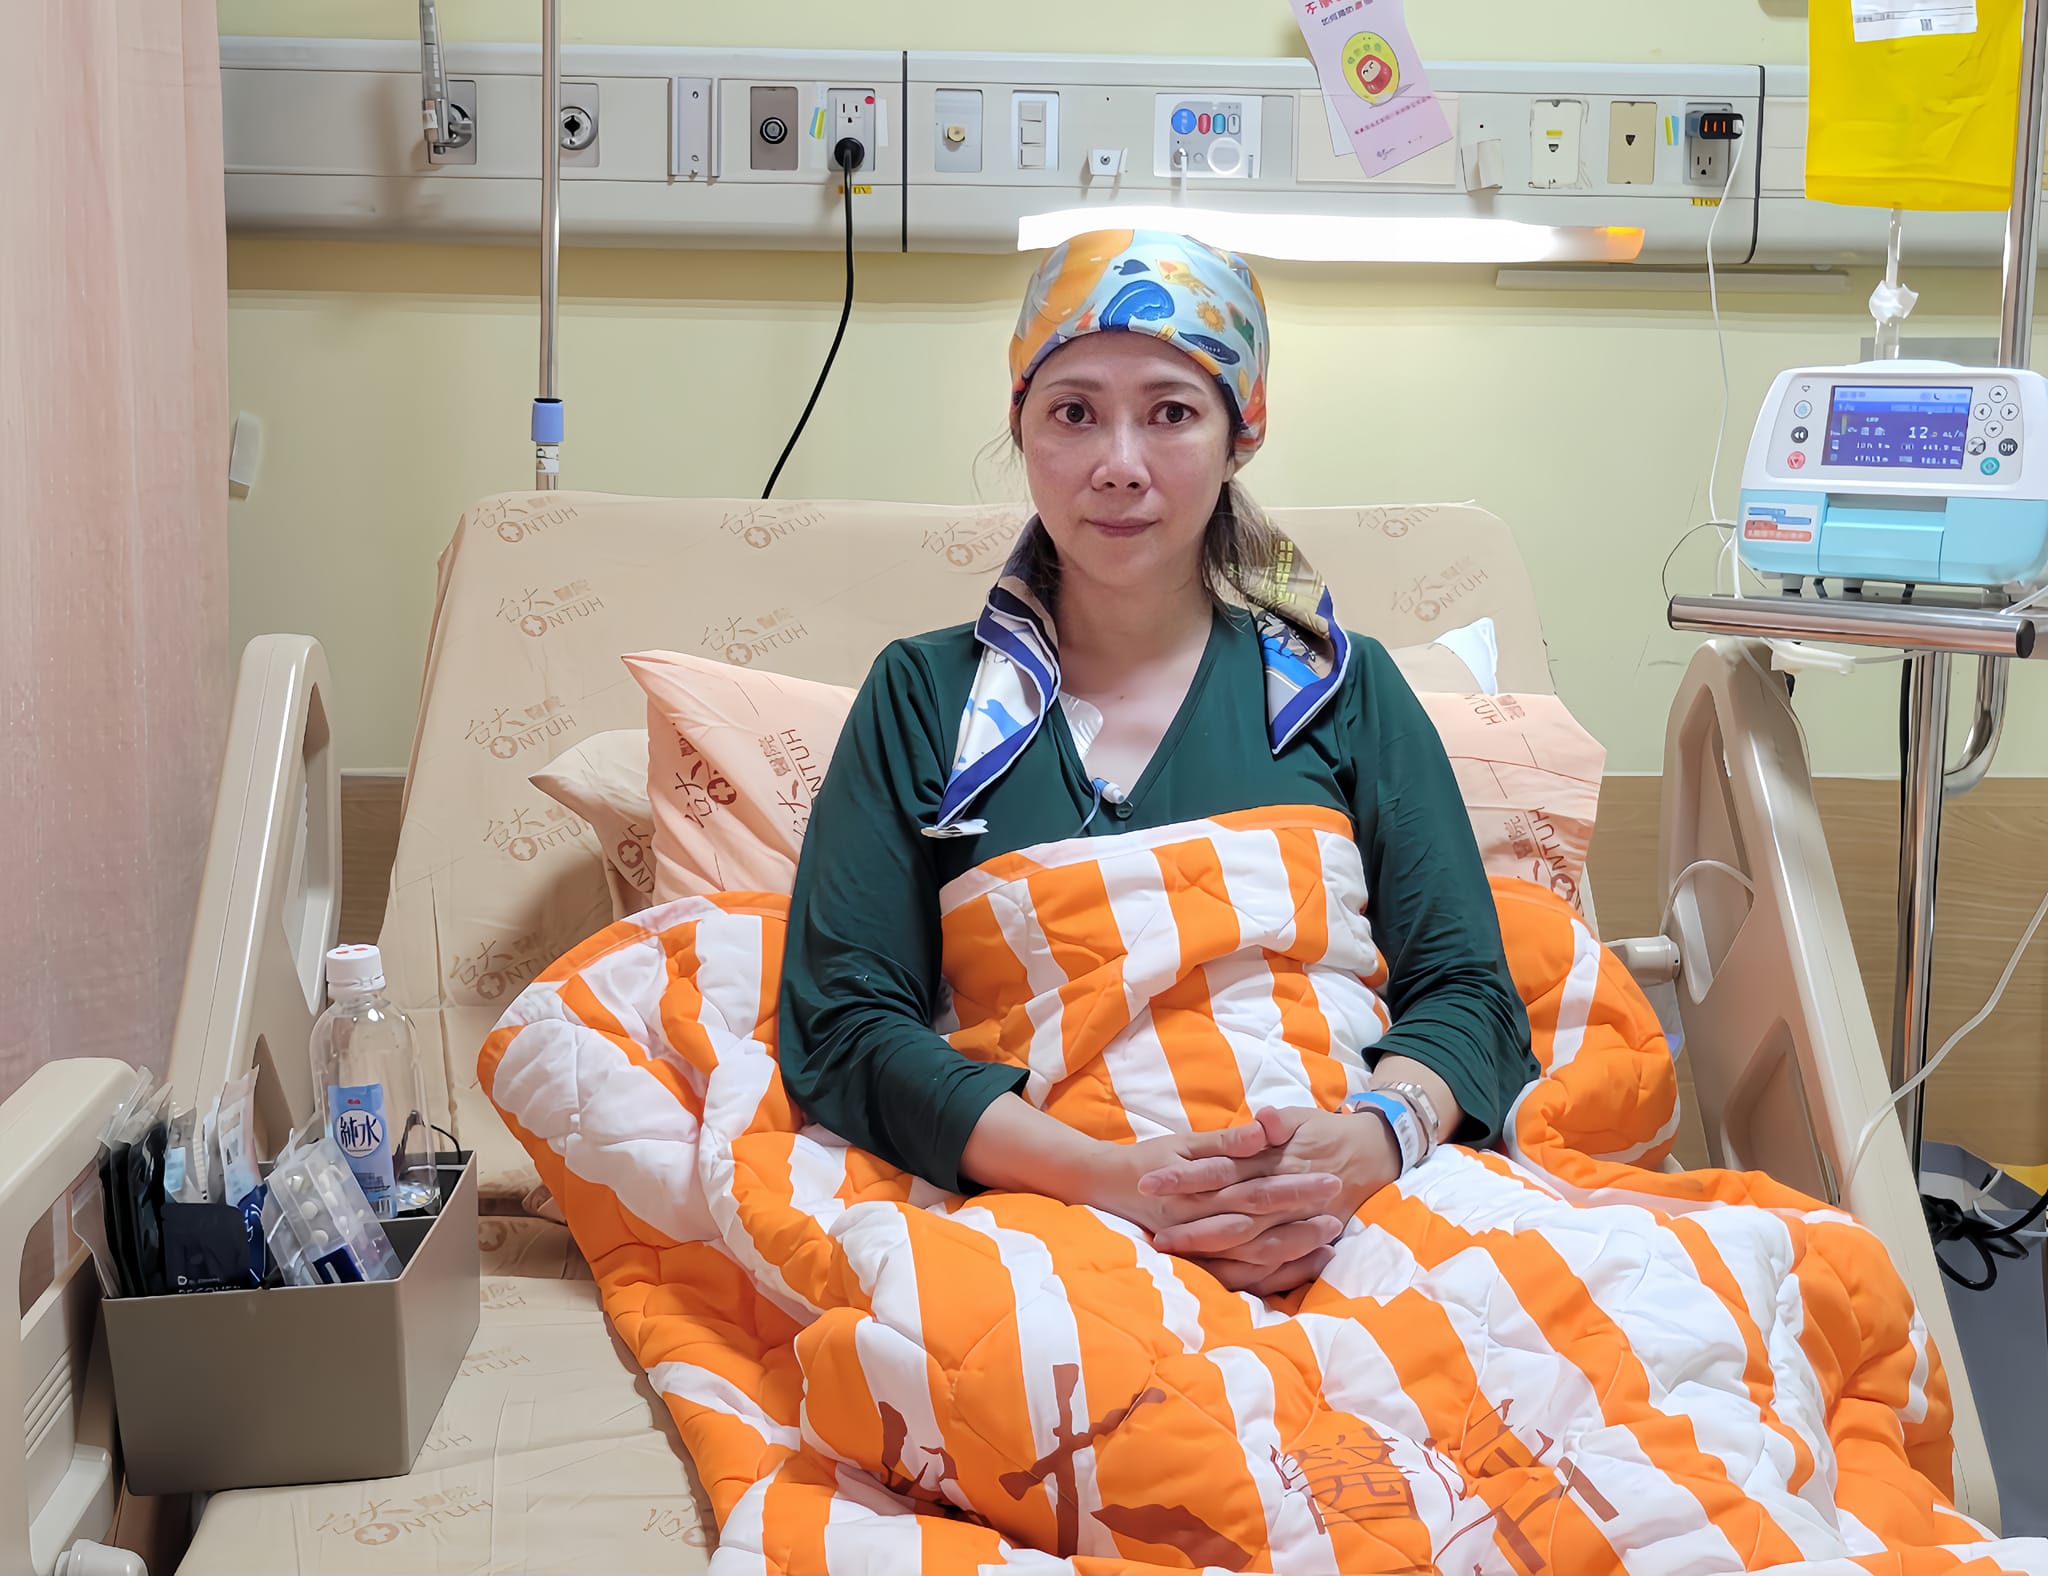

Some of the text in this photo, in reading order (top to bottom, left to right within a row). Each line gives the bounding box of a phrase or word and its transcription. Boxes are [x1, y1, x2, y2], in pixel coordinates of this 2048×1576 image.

[523, 506, 579, 535] NTUH
[970, 525, 1019, 556] NTU
[546, 596, 605, 628] NTUH
[751, 623, 809, 657] NTUH
[518, 714, 577, 750] NTUH
[1528, 806, 1572, 871] NTUH
[340, 1114, 380, 1148] 純水
[401, 1499, 493, 1534] NTUH
